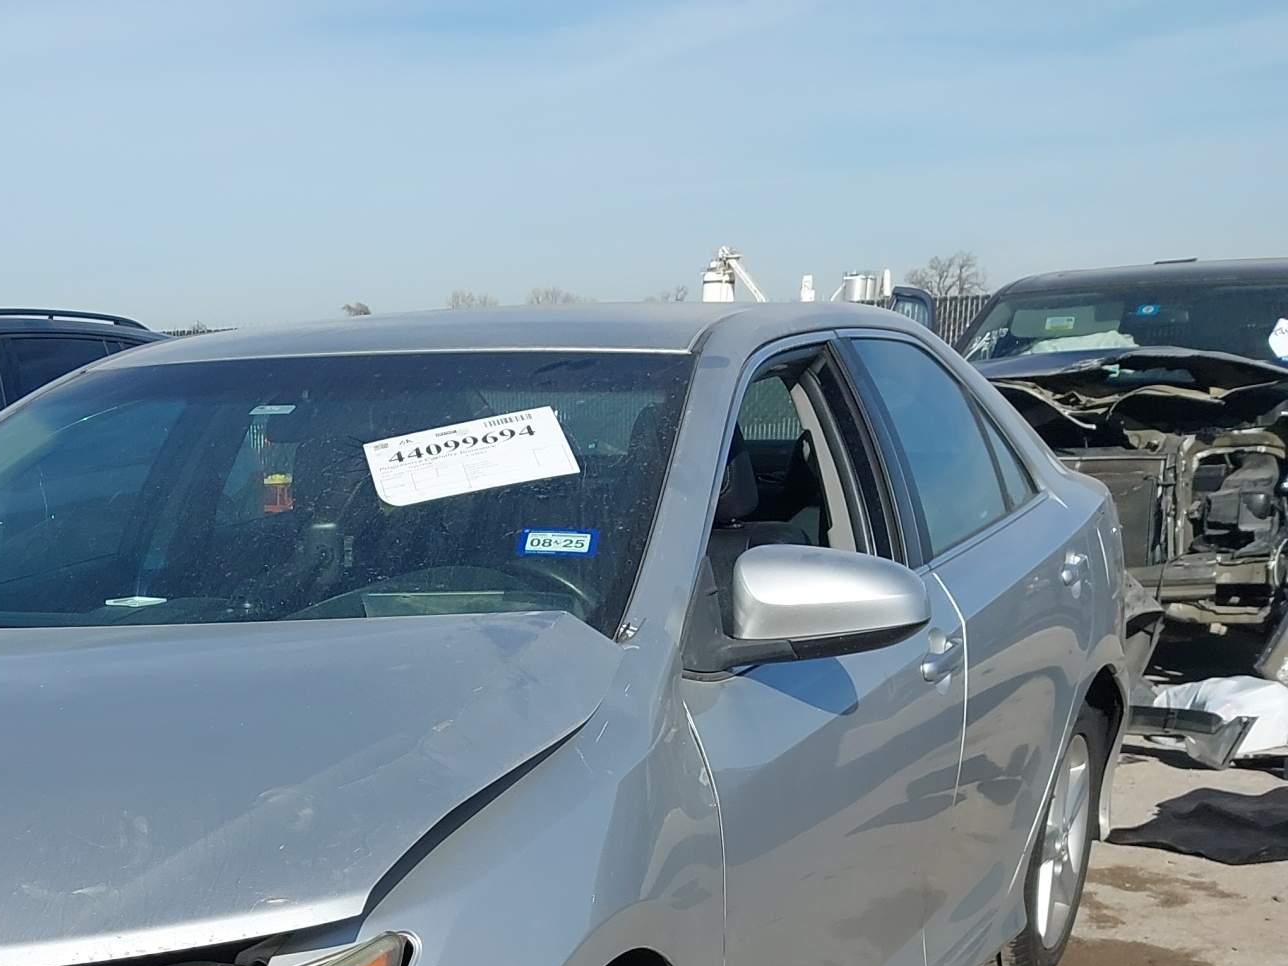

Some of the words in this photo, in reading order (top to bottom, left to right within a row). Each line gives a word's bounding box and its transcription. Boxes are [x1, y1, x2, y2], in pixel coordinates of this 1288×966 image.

[388, 425, 536, 463] 44099694
[530, 538, 552, 547] 08
[562, 539, 585, 548] 25
